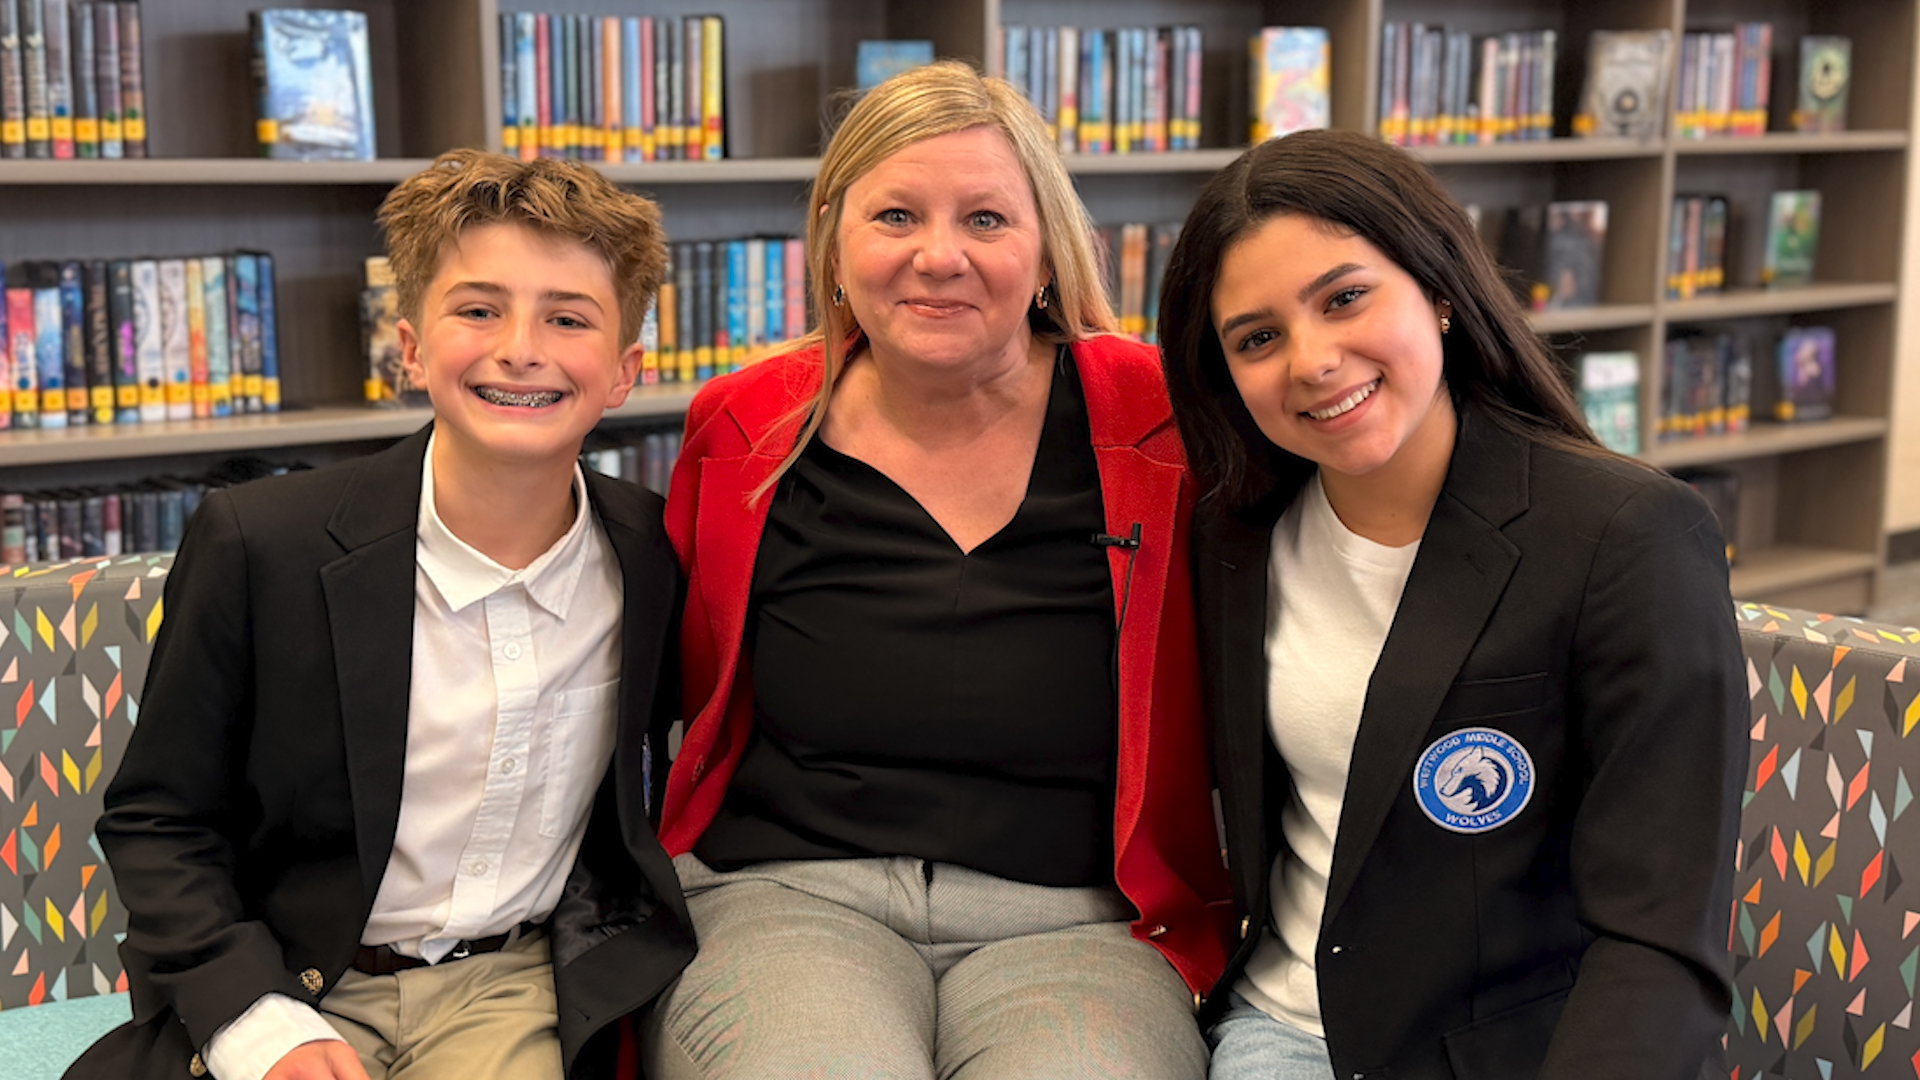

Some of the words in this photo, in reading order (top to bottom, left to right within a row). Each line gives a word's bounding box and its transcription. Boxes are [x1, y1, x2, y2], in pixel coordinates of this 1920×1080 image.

[1420, 737, 1460, 788] WESTWOOD
[1465, 733, 1506, 748] MIDDLE
[1506, 746, 1529, 785] SCHOOL
[1445, 811, 1502, 827] WOLVES
